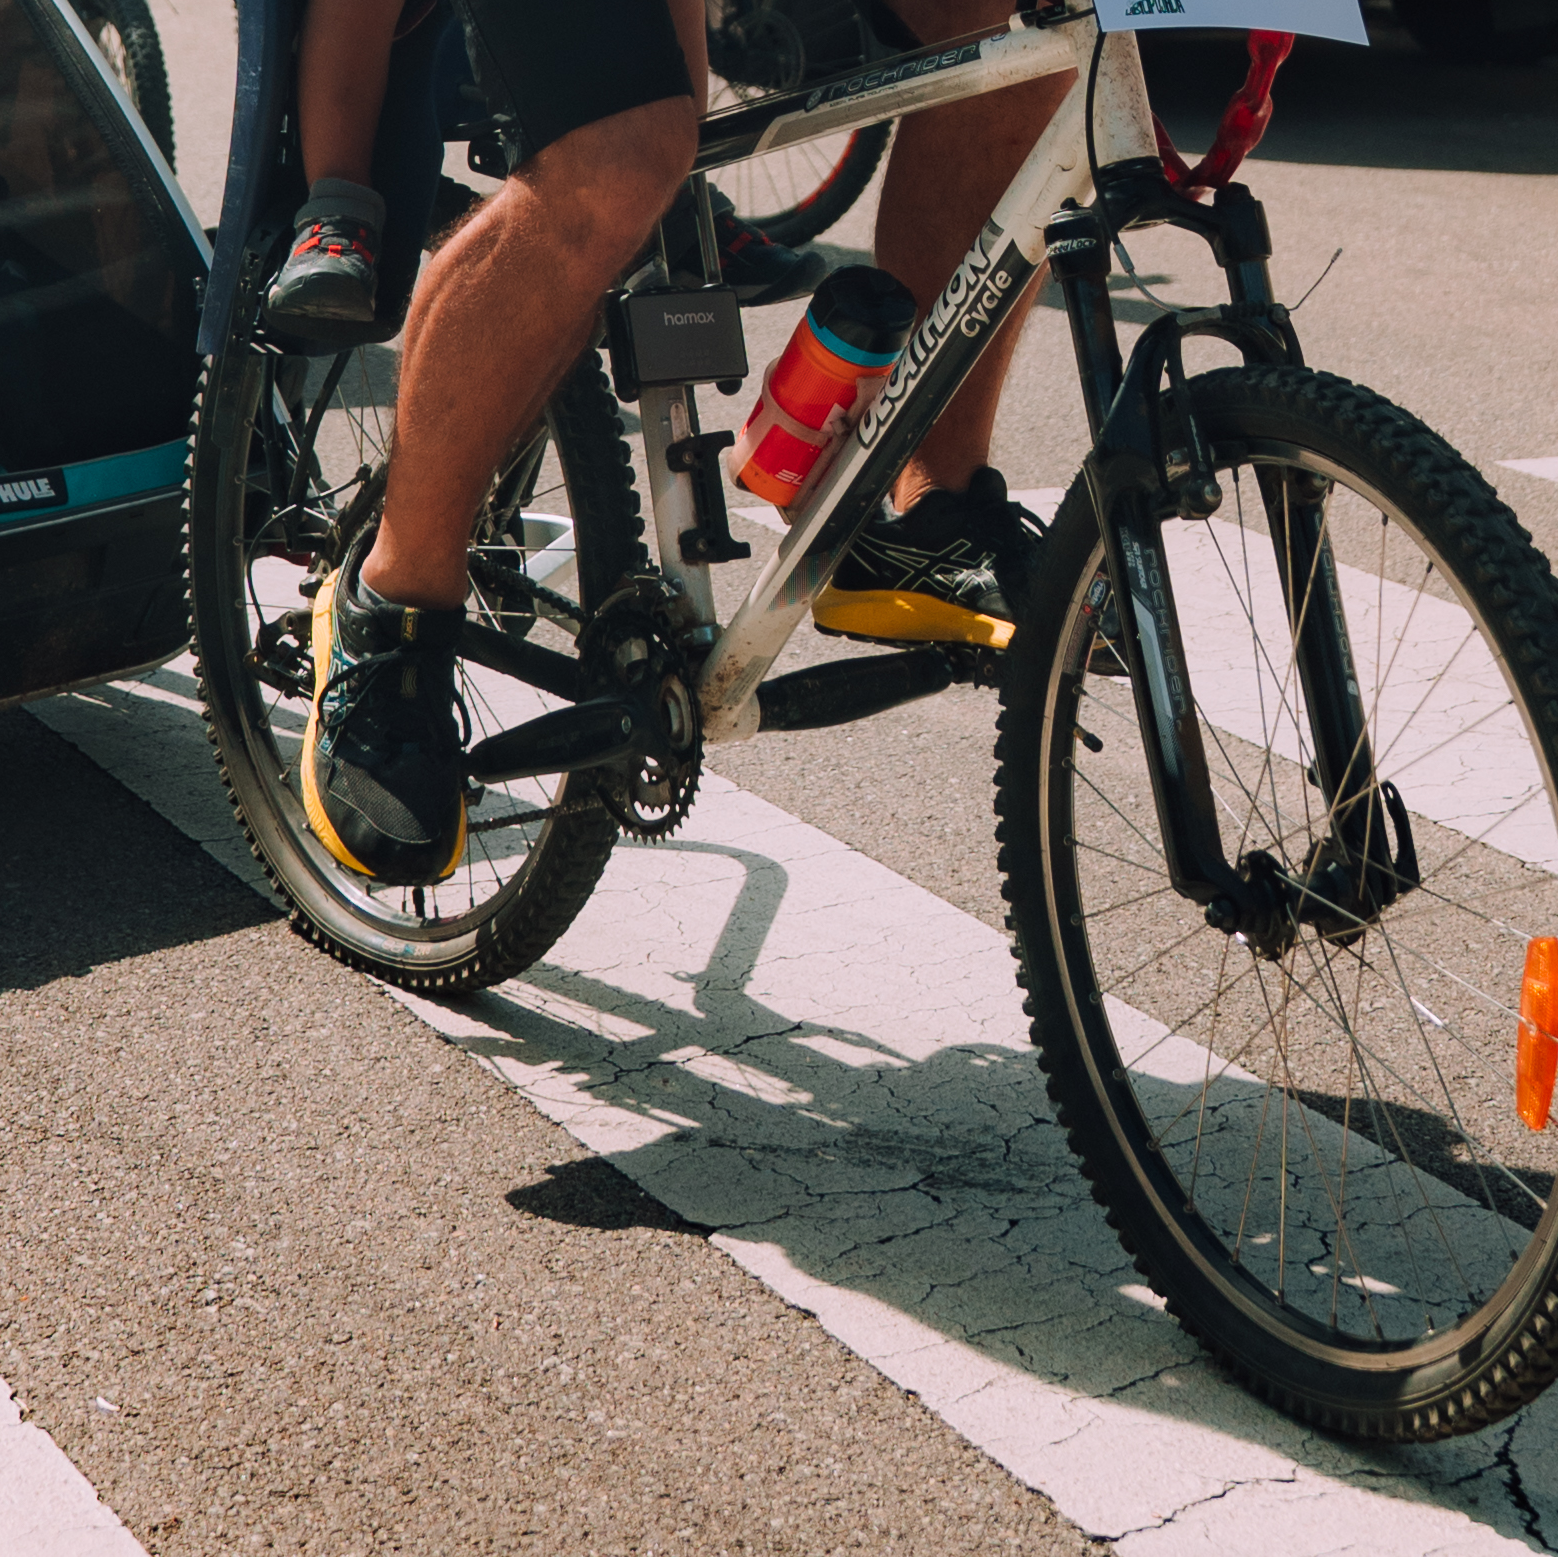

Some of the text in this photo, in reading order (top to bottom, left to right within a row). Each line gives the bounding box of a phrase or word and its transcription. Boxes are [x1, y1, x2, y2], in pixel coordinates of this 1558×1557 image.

[662, 310, 717, 327] hamax
[959, 269, 1013, 338] Cycle
[856, 235, 992, 450] DECATHLON
